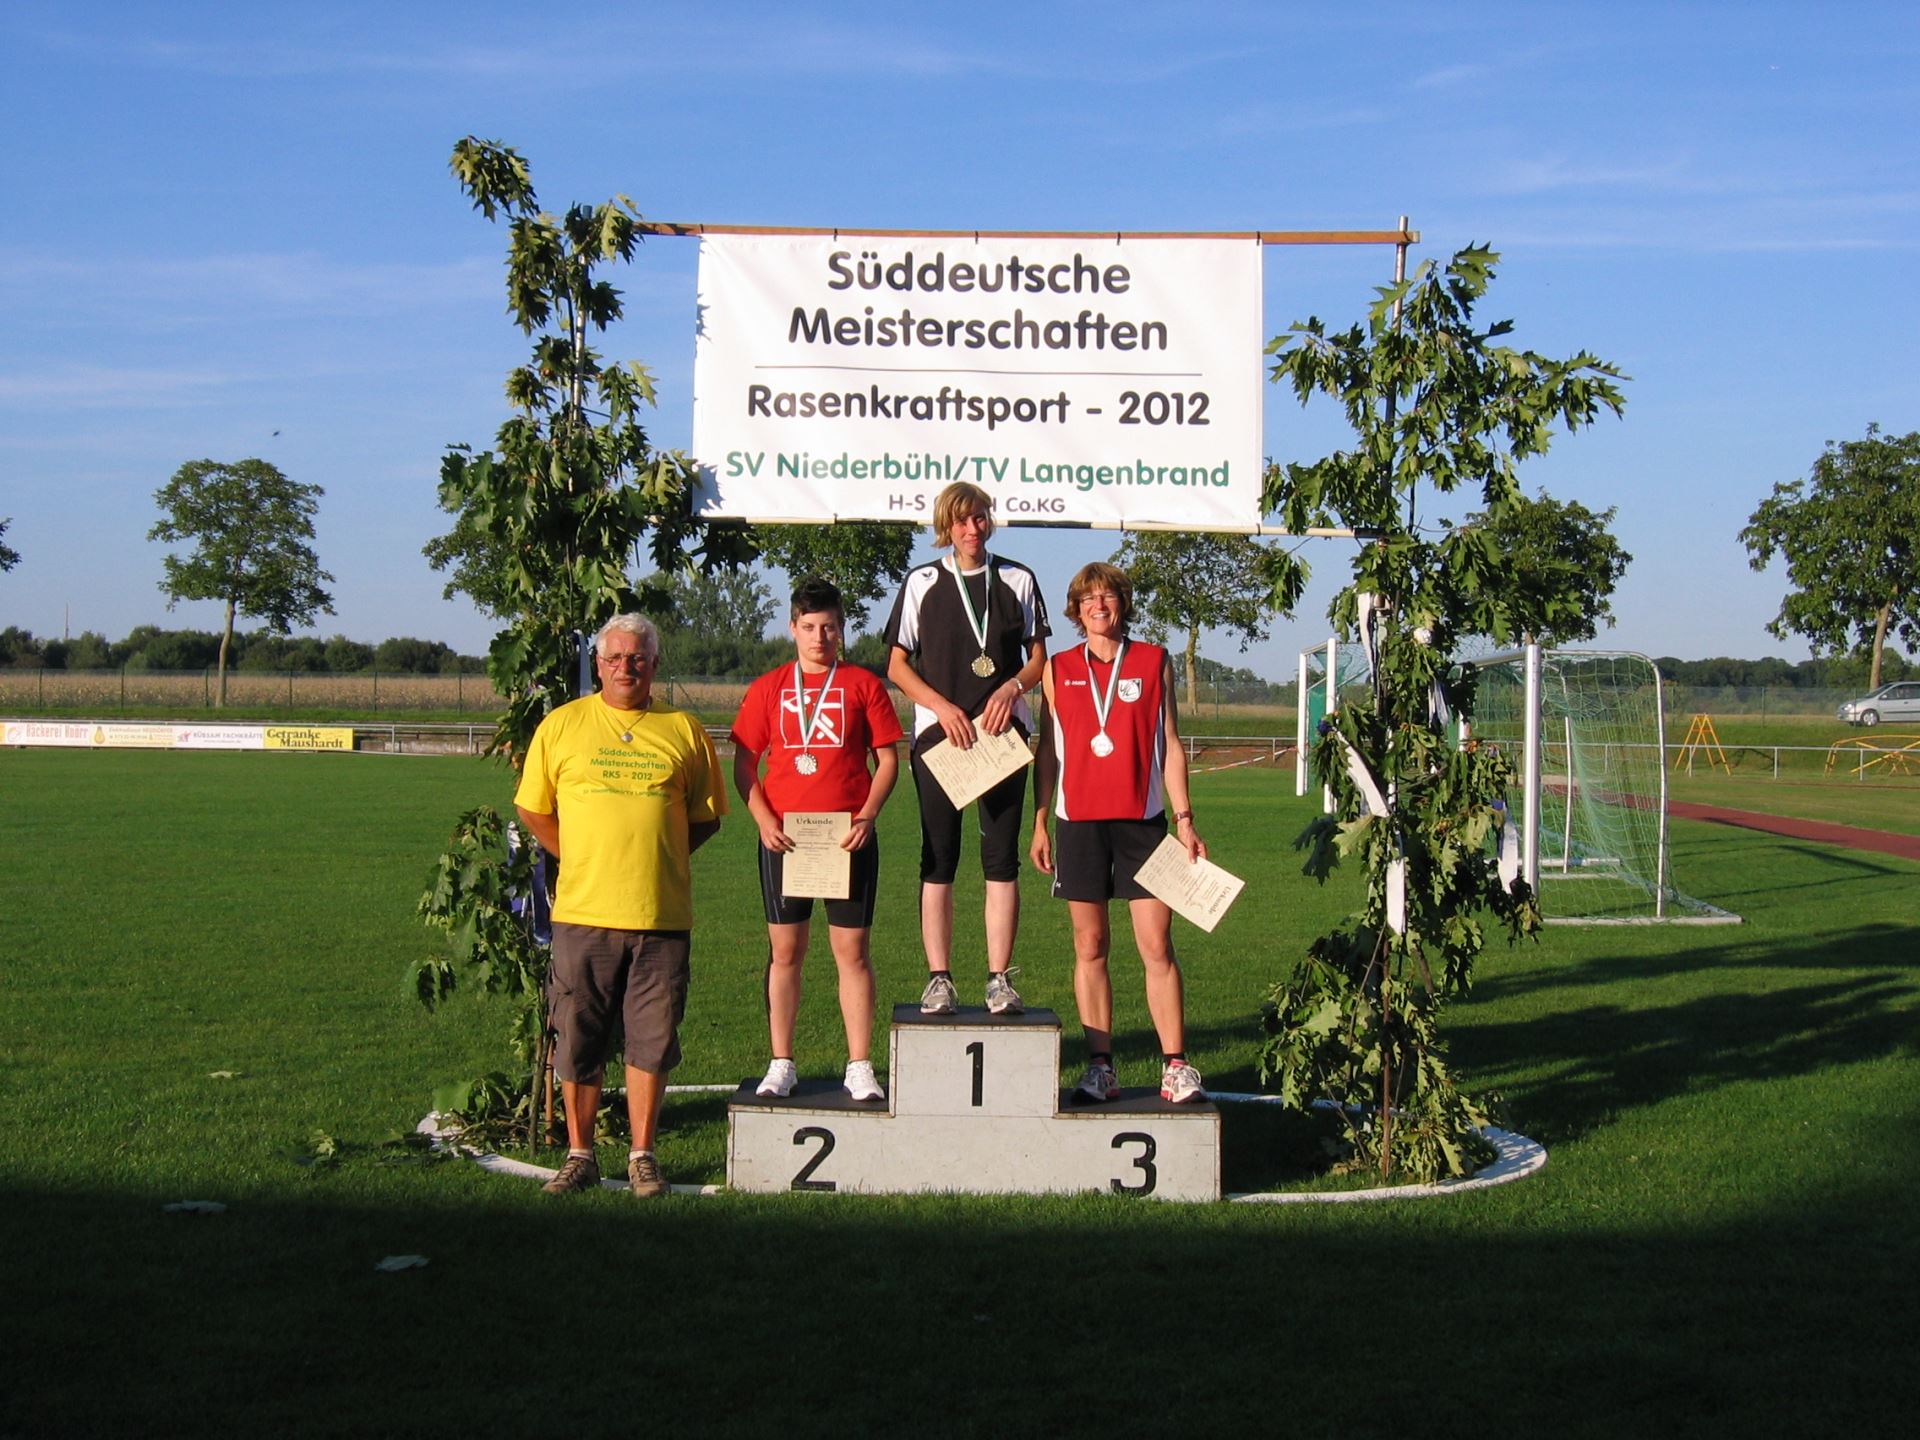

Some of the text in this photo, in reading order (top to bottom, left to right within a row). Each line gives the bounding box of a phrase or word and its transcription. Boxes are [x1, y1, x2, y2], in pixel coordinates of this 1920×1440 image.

[828, 251, 1131, 294] Süddeutsche
[788, 306, 1168, 351] Meisterschaften
[748, 384, 1070, 430] Rasenkraftsport
[1118, 391, 1210, 426] 2012
[726, 451, 1230, 492] SV Niederbühl/TV Langenbrand
[889, 494, 926, 511] H-S
[1006, 497, 1065, 513] Co.KG
[280, 737, 344, 748] Maushardt
[598, 747, 658, 759] Süddeutsche
[590, 758, 667, 770] Meisterschaften
[602, 770, 621, 779] RKS
[631, 771, 653, 781] 2012
[796, 817, 834, 825] Urkunde
[965, 1041, 984, 1107] 1
[791, 1126, 837, 1192] 2
[1109, 1131, 1158, 1197] 3
